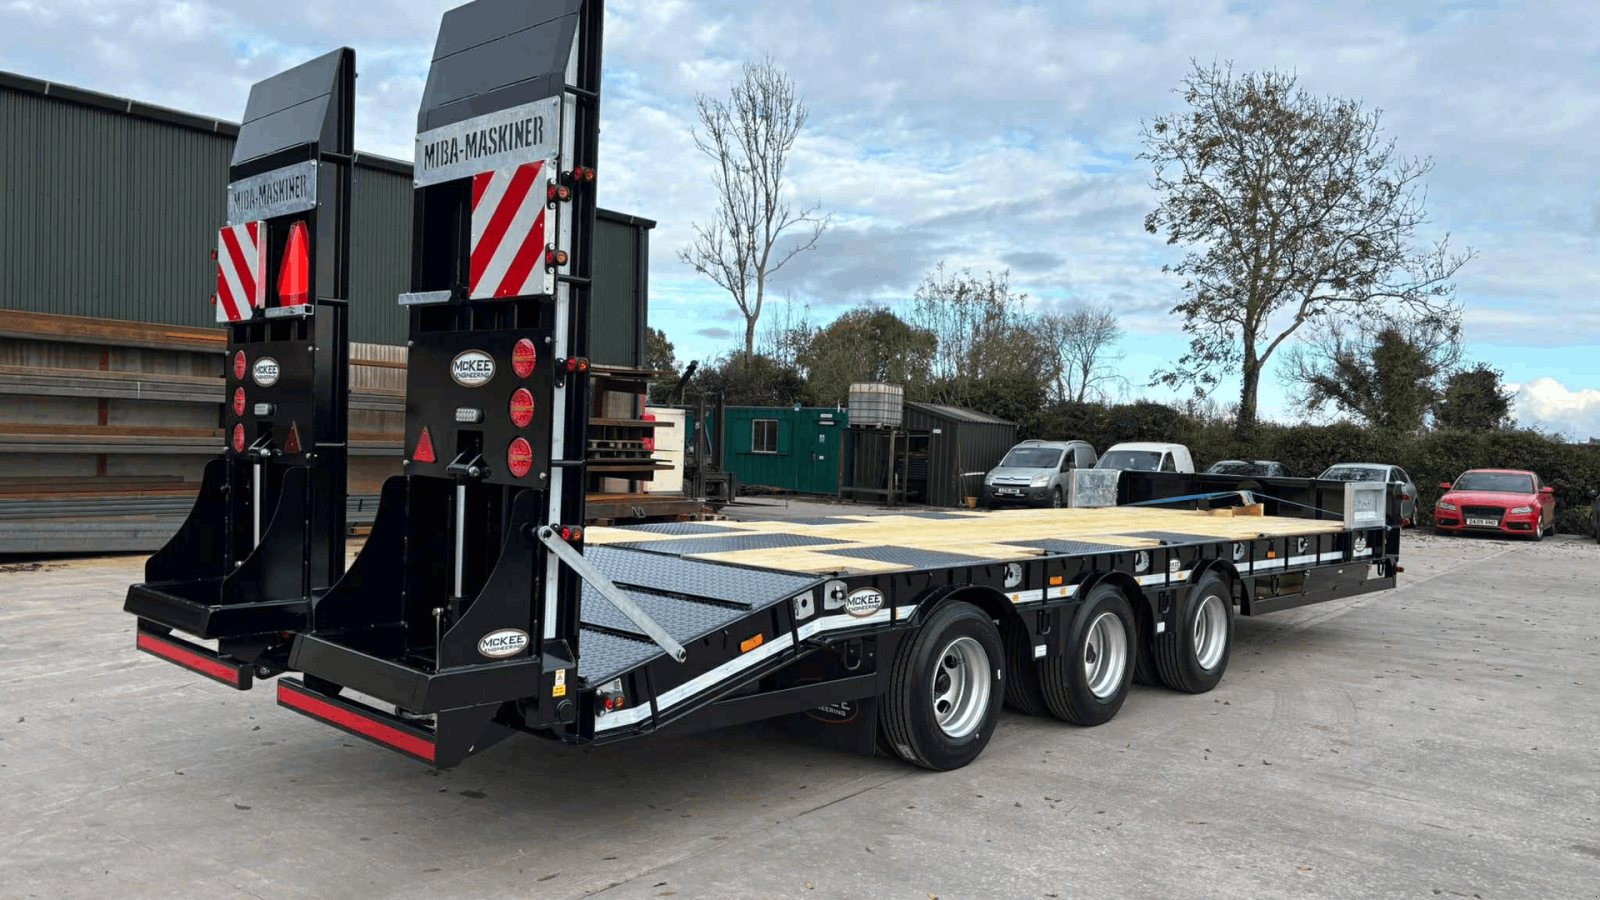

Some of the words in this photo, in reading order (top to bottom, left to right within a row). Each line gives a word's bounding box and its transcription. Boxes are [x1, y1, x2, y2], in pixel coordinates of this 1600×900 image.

[424, 116, 543, 170] MIBA-MASKINER
[234, 174, 307, 212] MIBA-MASKINER
[456, 371, 490, 379] ENGINEERING
